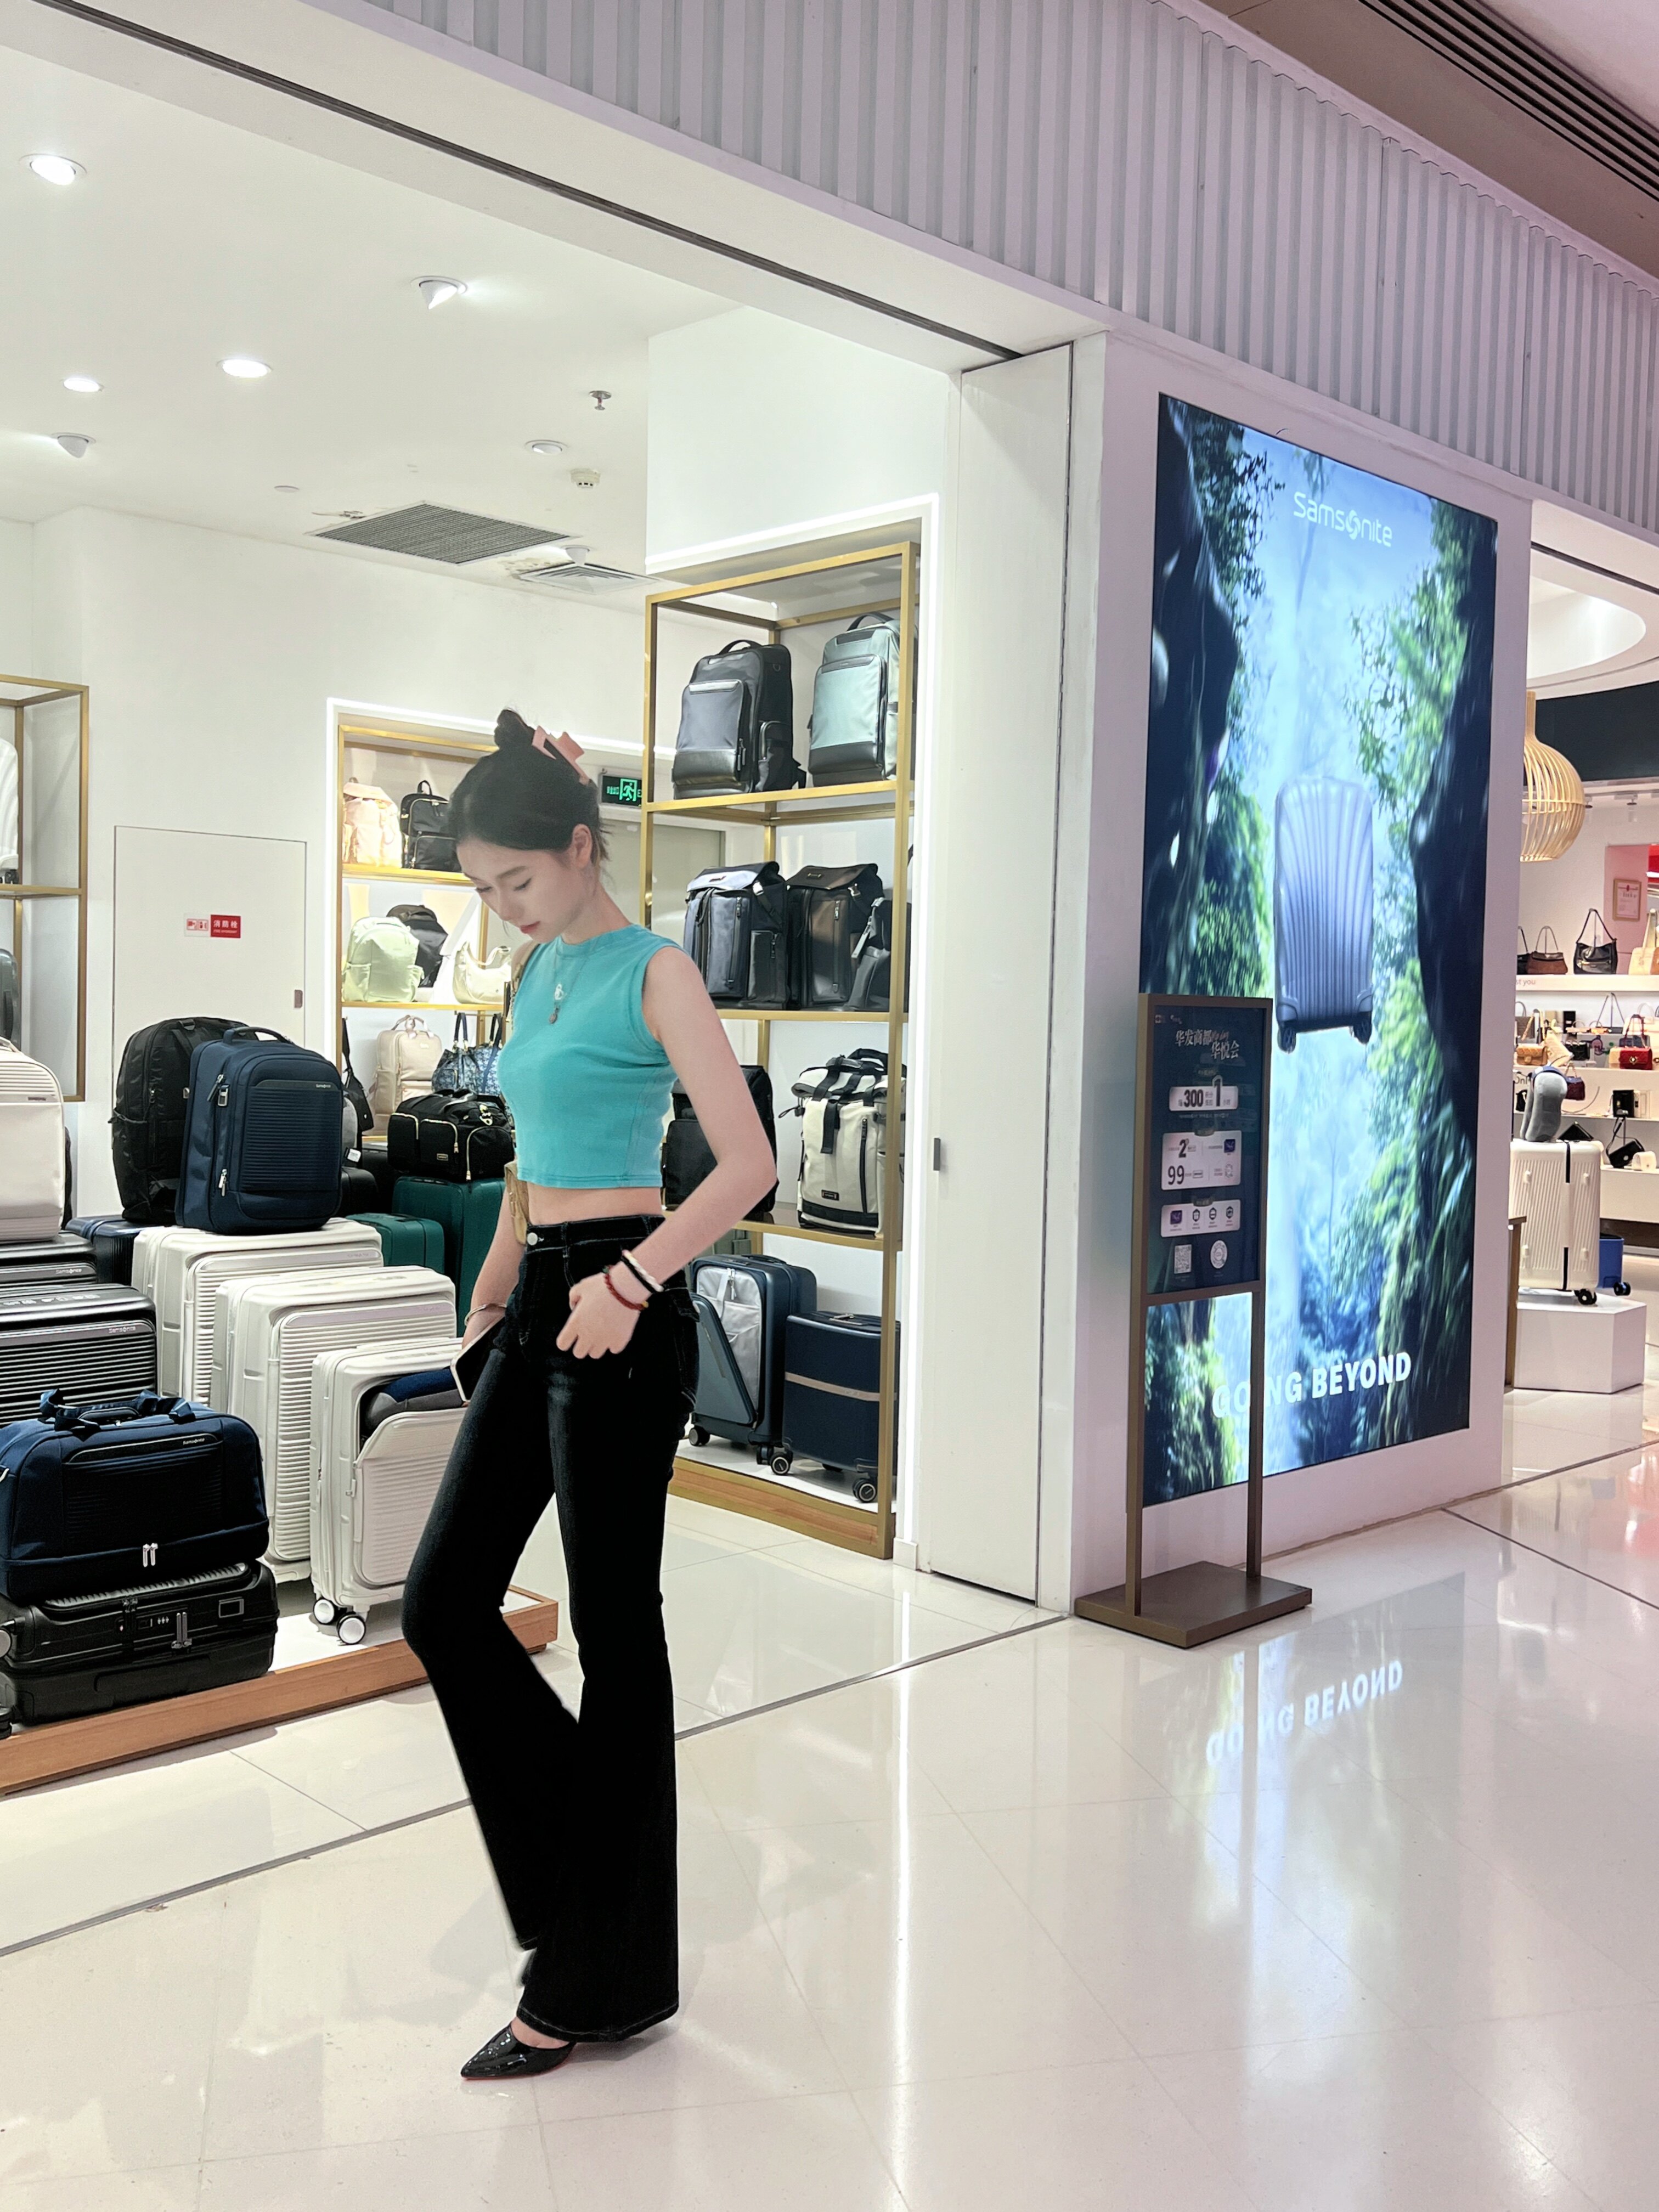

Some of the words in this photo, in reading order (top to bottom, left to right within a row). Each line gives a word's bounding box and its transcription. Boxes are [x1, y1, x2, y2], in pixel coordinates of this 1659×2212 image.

[1293, 491, 1393, 547] Samsonite
[1175, 1029, 1212, 1047] 华发商都
[1211, 1040, 1240, 1060] 华悦会
[1183, 1089, 1204, 1108] 300
[1214, 1078, 1221, 1107] 1
[1178, 1139, 1187, 1158] 2
[1167, 1165, 1184, 1185] 99
[1212, 1372, 1302, 1418] GONG
[1312, 1352, 1412, 1399] BEYOND
